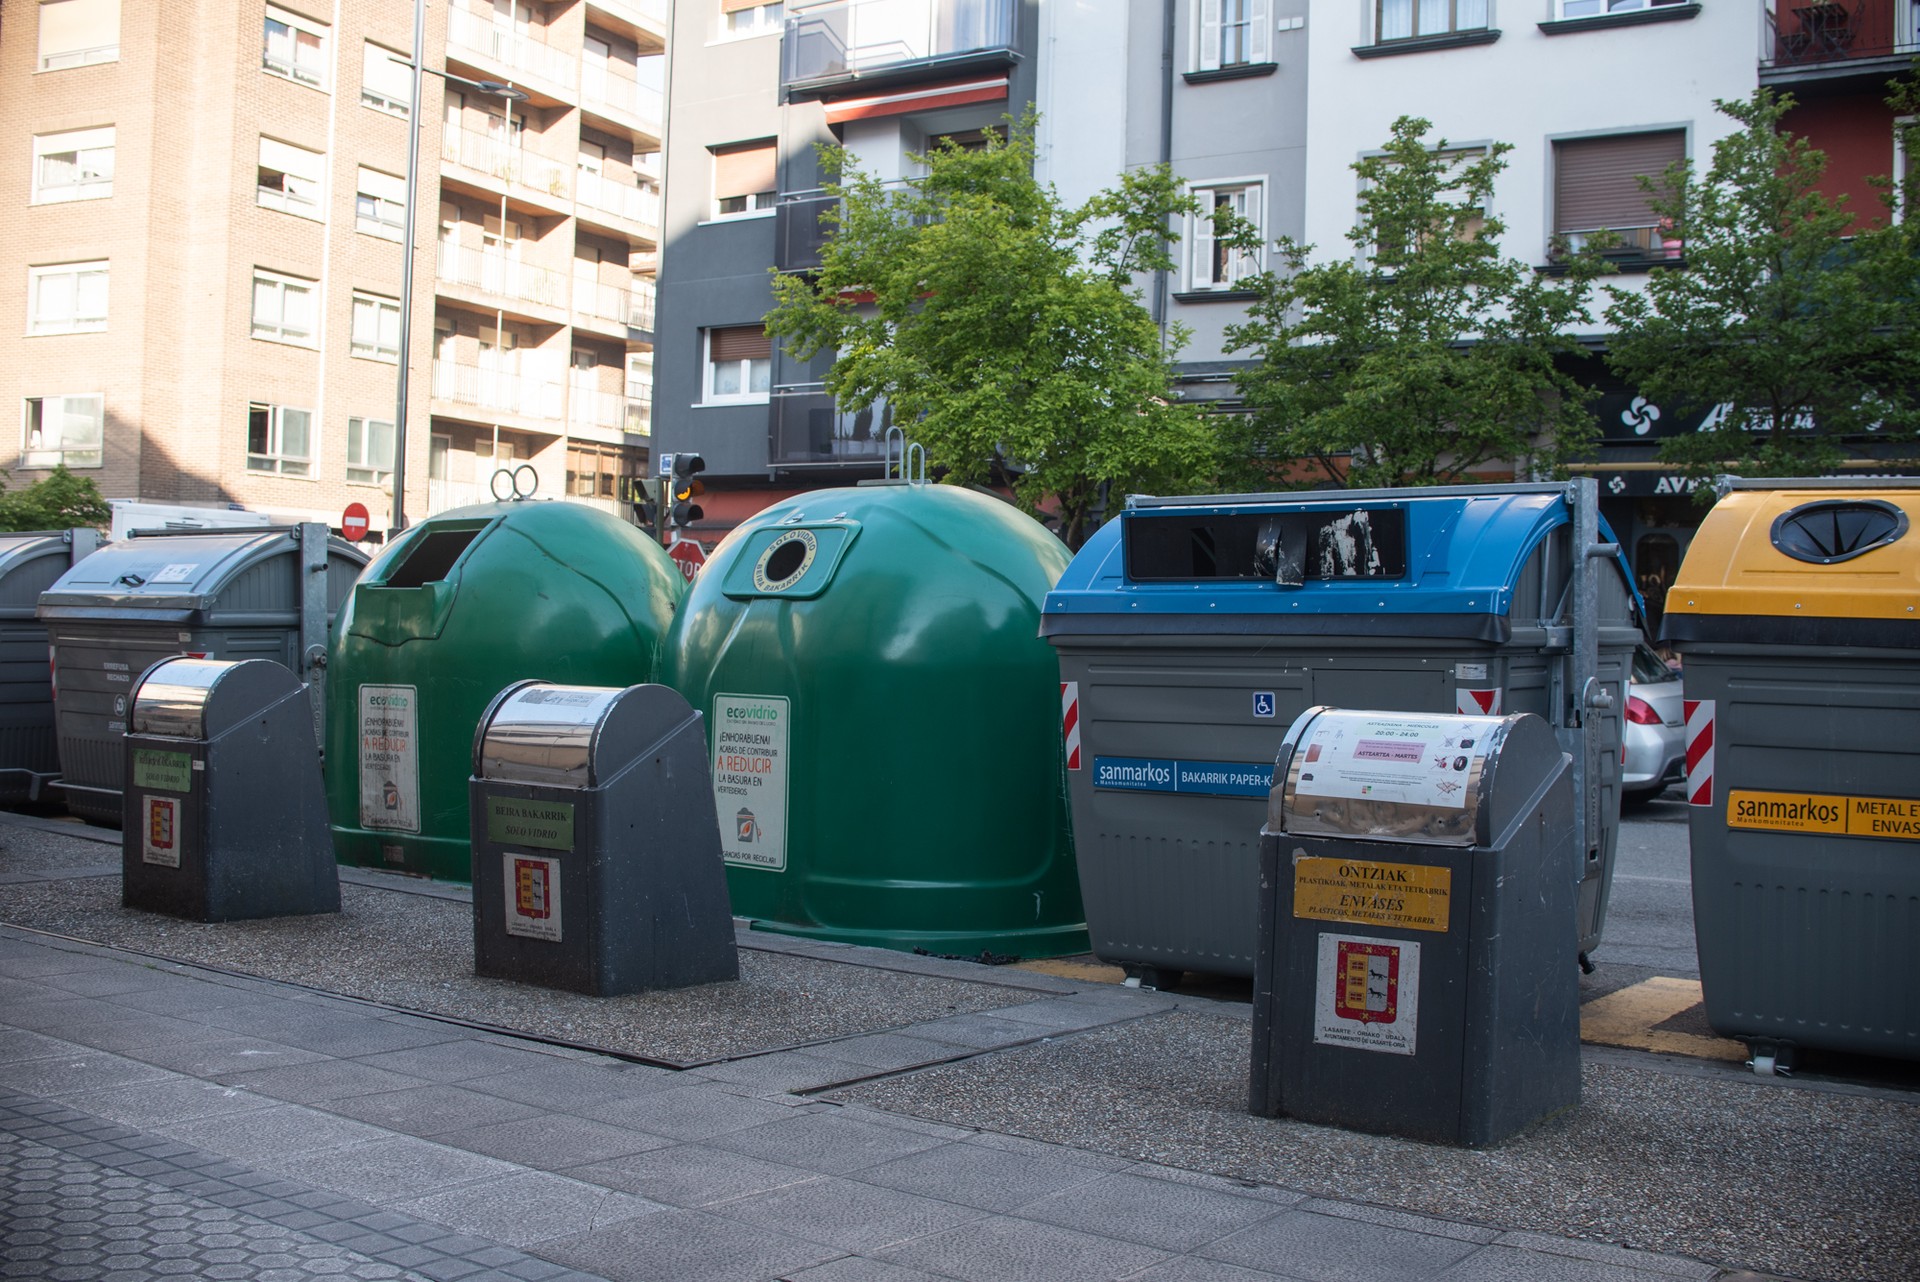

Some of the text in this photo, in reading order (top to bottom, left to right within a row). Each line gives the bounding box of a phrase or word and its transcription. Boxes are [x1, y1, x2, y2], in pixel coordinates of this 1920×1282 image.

[769, 530, 816, 552] SOLO VIDRIO
[672, 558, 702, 577] TOP
[756, 563, 809, 592] BEIRA BAKARRIK
[726, 704, 778, 721] ecovidrio
[719, 746, 738, 754] ACABAS
[747, 748, 778, 757] CONTRIBUIR
[1357, 750, 1390, 758] ASTEARTEA
[1394, 752, 1418, 760] MARTES
[717, 755, 772, 774] A REDUCIR
[718, 774, 762, 787] LA BASURA EN
[1100, 762, 1170, 784] sanmarkos
[1181, 771, 1274, 786] BAKARRIK PAPER-K
[717, 786, 748, 796] VERTEDEROS
[495, 806, 567, 821] BEIRA BAKARRIK
[1737, 798, 1839, 825] sanmarkos
[1856, 801, 1906, 816] METAL
[1737, 816, 1804, 827] Mankomunitatea
[505, 824, 557, 840] SOLO VIDRIO
[741, 852, 752, 861] POR
[1338, 864, 1408, 883] ONTZIAK
[1349, 880, 1386, 891] METALAK
[1388, 883, 1403, 892] ETA
[1404, 884, 1448, 896] TETRABRIK
[1339, 893, 1405, 912] ENVASES
[1351, 909, 1386, 920] METALES
[1387, 912, 1393, 920] Y
[1393, 913, 1436, 925] TETRABRIK
[1324, 1026, 1351, 1035] LASARTE
[1357, 1030, 1380, 1038] ORIAKO
[1385, 1034, 1406, 1042] UDALA
